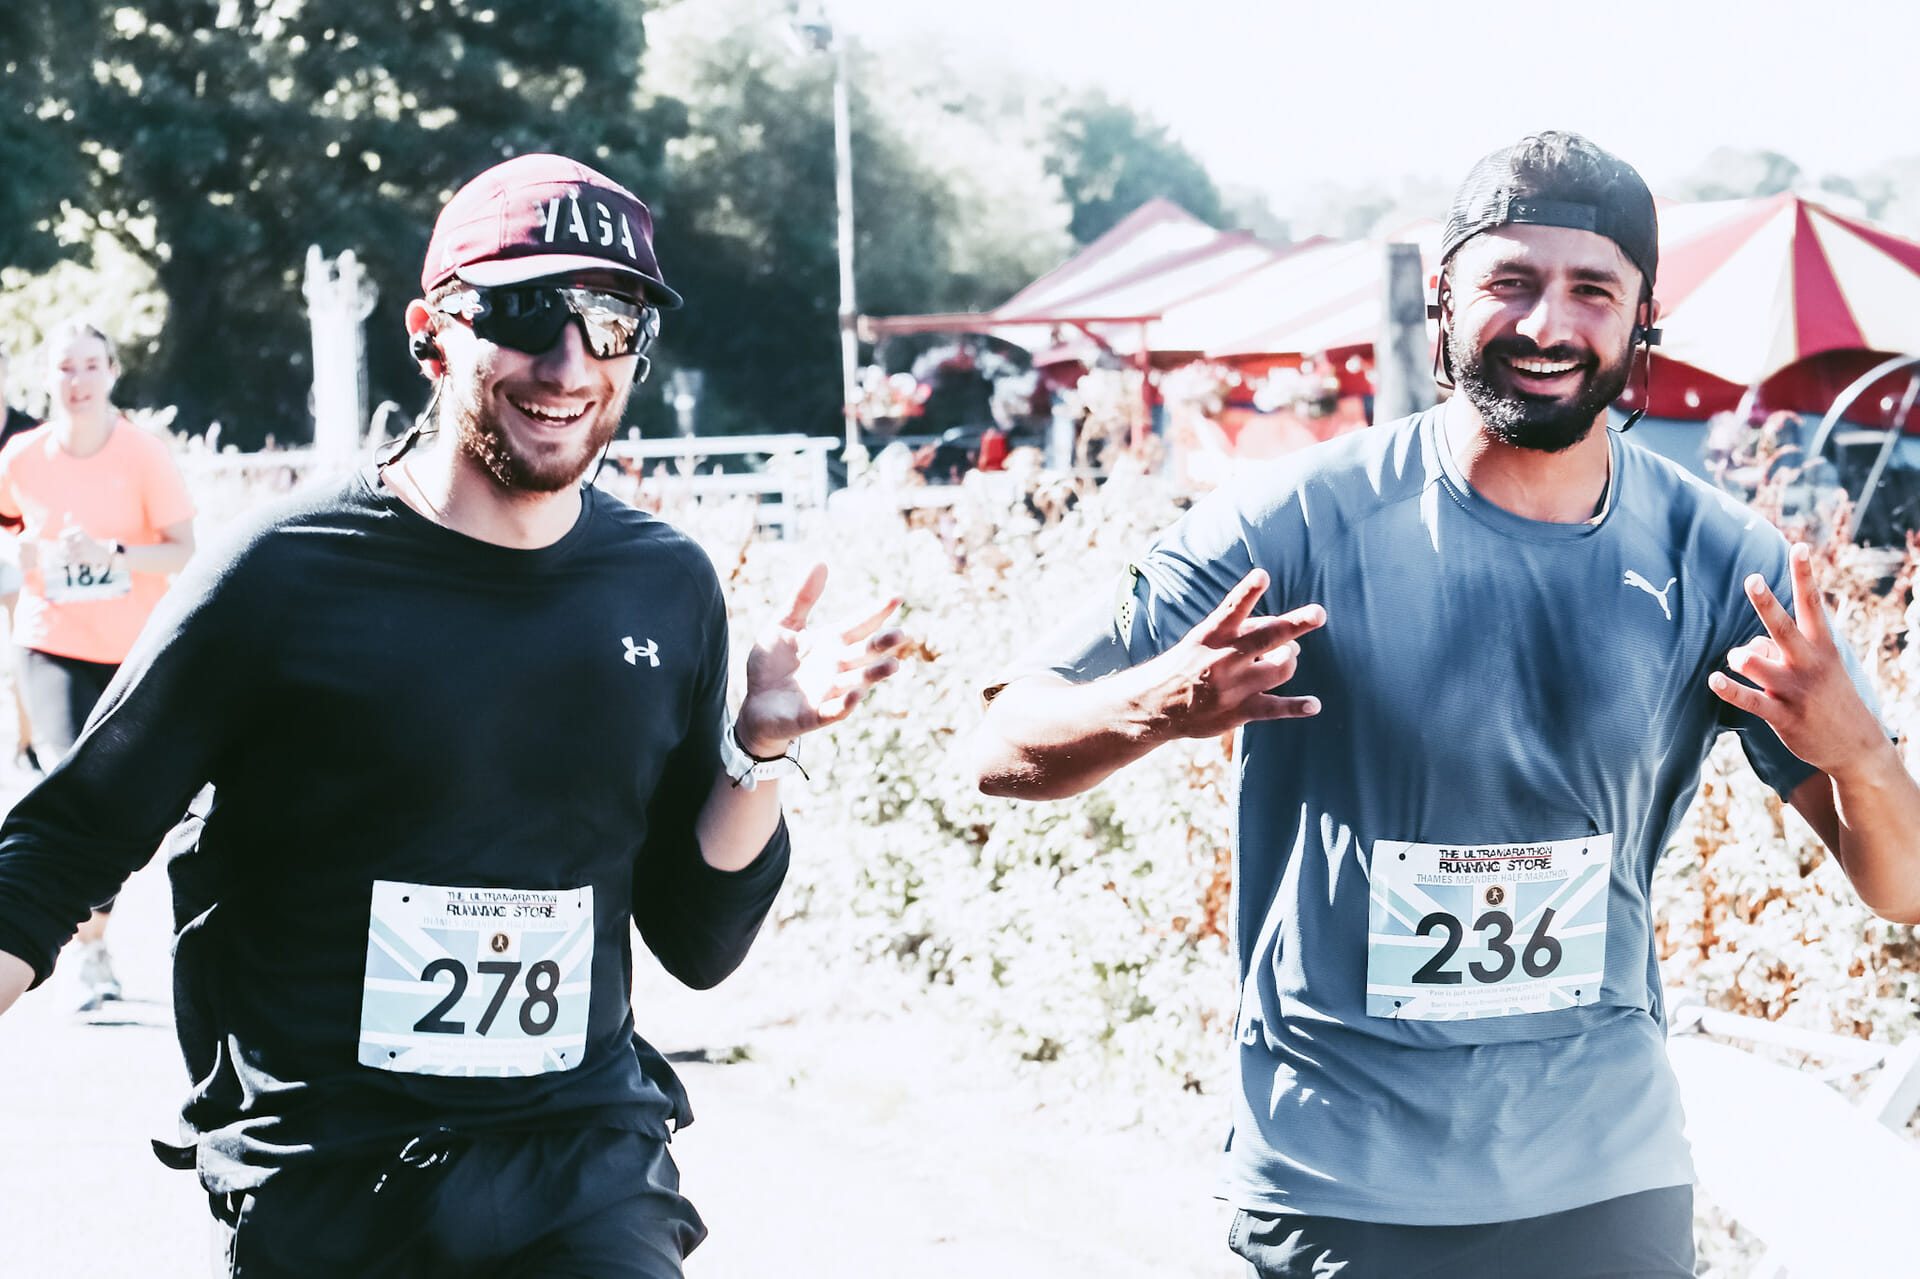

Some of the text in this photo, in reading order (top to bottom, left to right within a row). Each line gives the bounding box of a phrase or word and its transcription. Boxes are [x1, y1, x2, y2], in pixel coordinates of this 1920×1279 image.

[63, 563, 114, 588] 182
[1438, 846, 1553, 859] THE ULTRAMARATHON
[1438, 858, 1552, 874] RUNNING STORE
[1416, 869, 1569, 884] THAMES MEANDER HALF MARATHON
[446, 903, 556, 919] RUNNING STORE
[1411, 907, 1563, 985] 236
[412, 957, 561, 1037] 278
